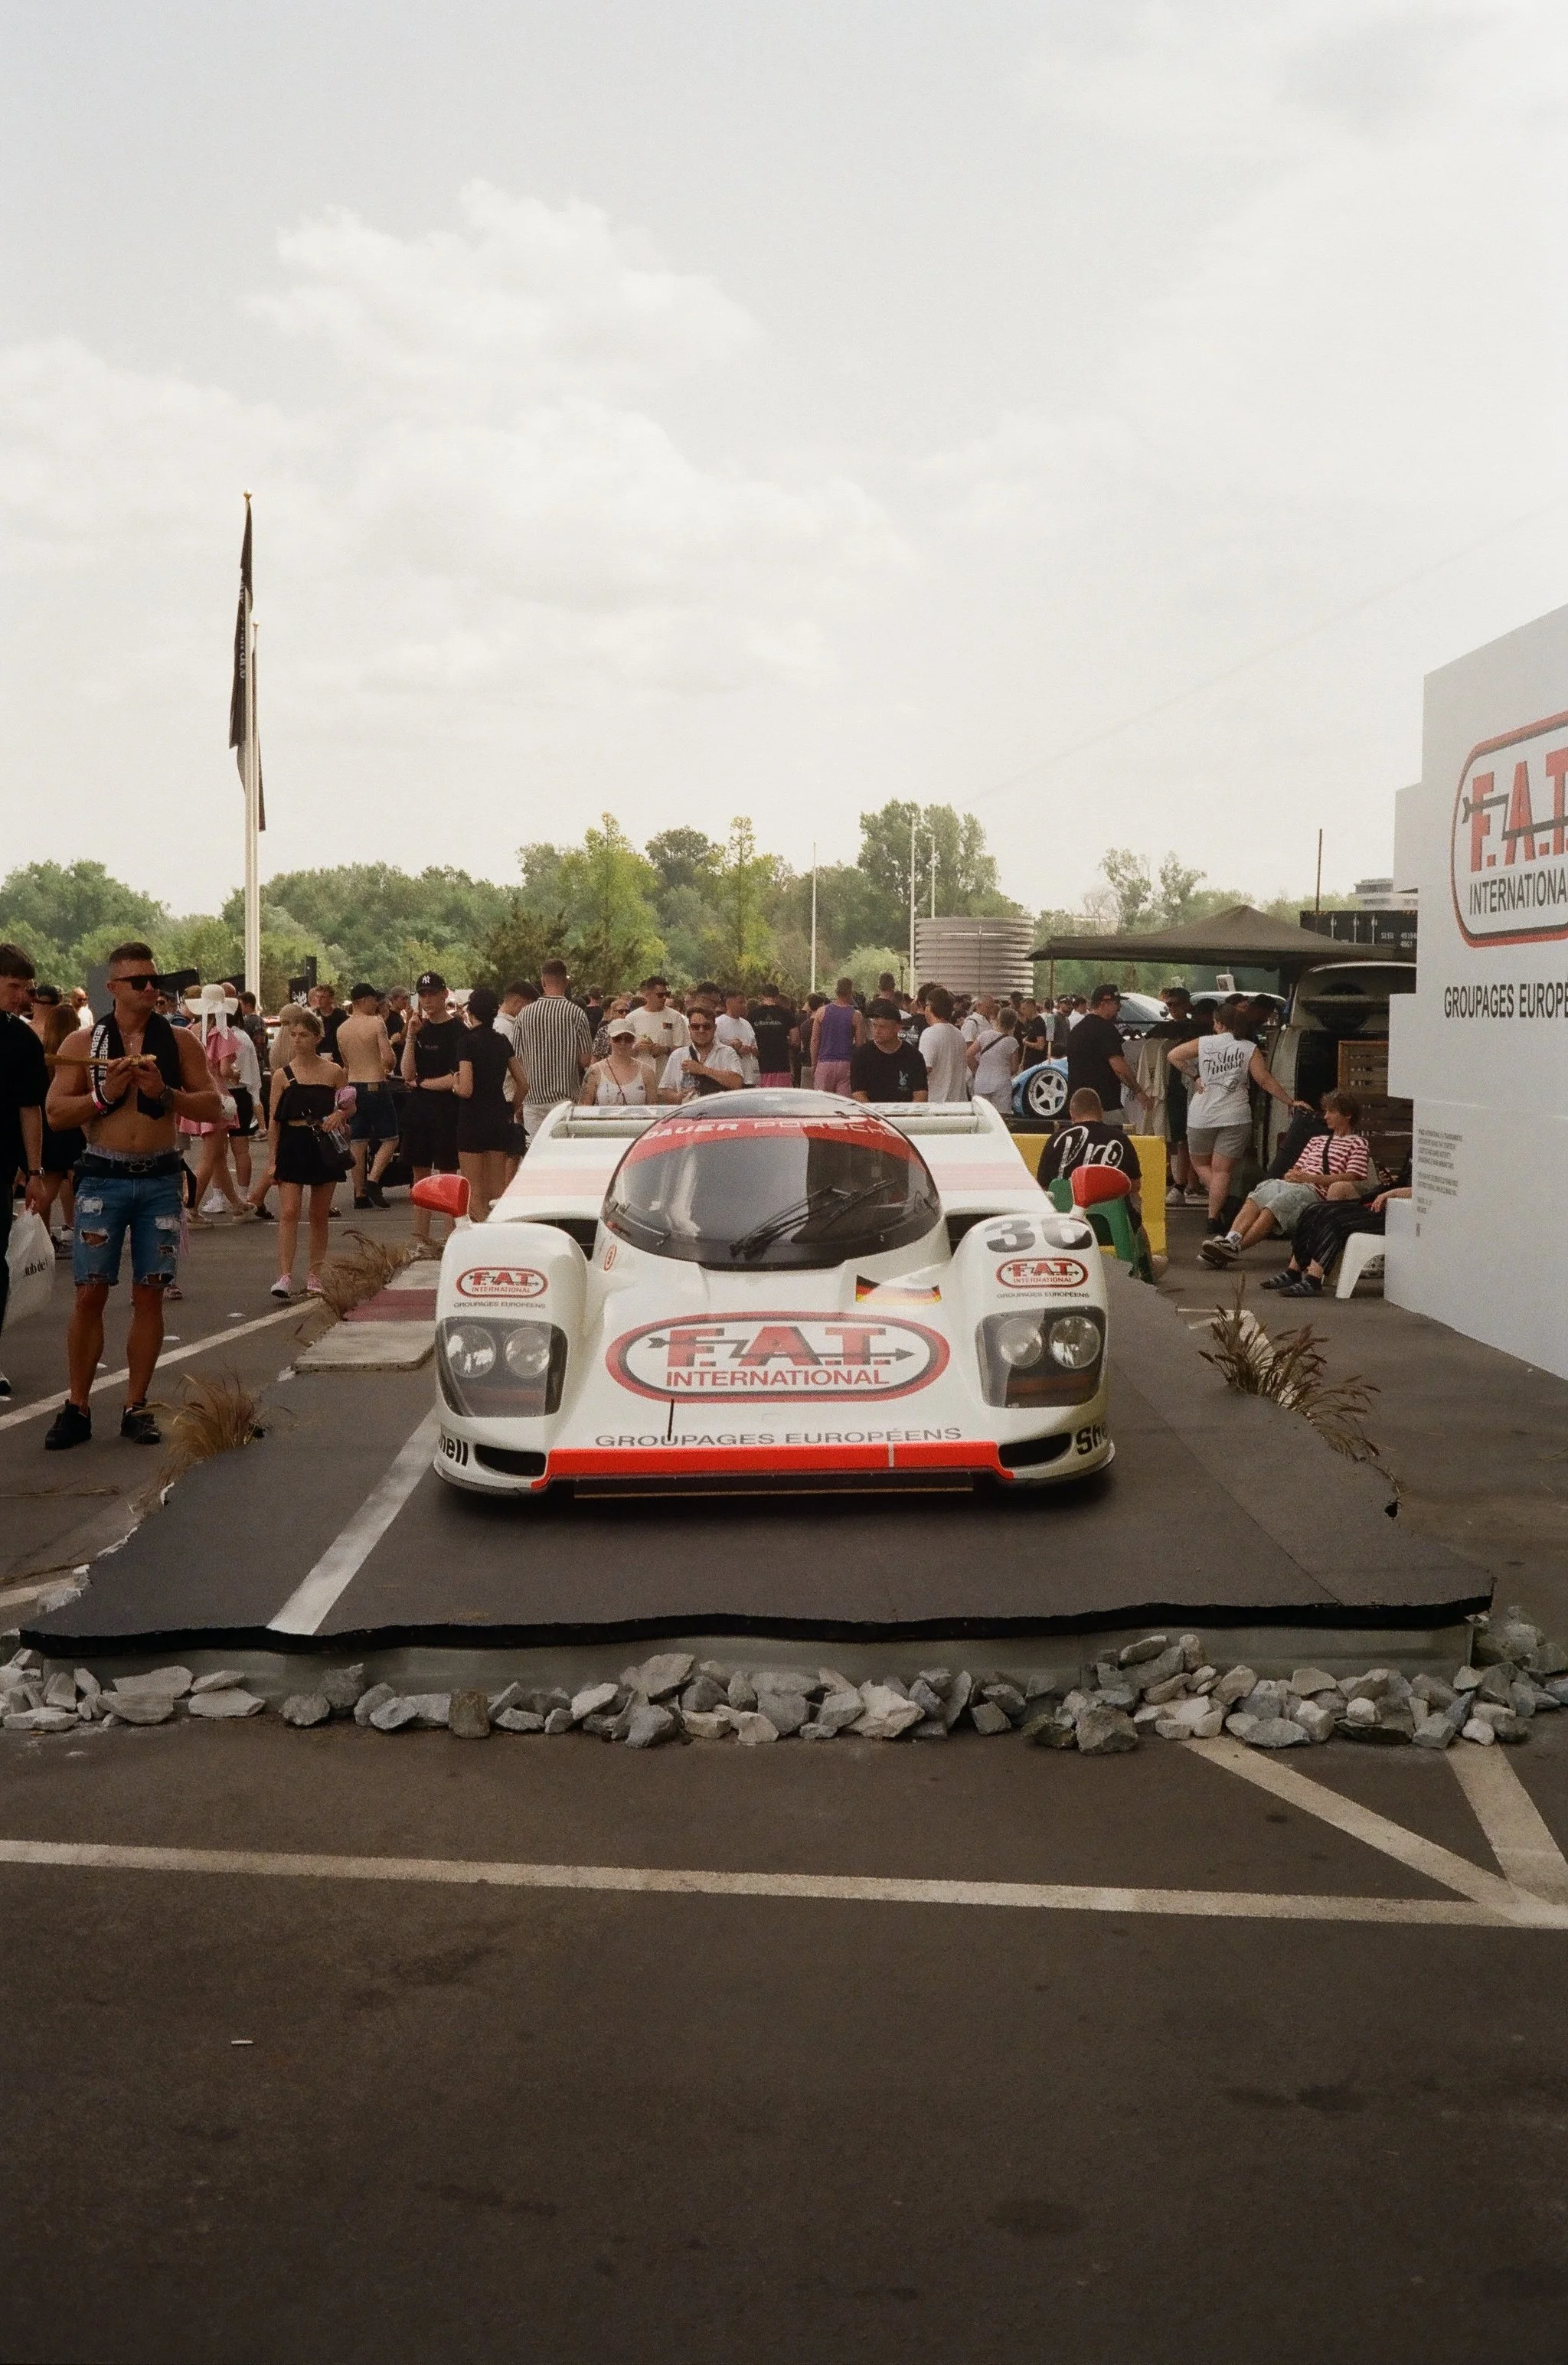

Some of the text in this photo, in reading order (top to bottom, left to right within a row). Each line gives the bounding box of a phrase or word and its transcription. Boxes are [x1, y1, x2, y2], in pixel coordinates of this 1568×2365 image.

[1444, 983, 1514, 1018] GROUPAGES
[1217, 1045, 1244, 1063] Auto
[985, 1217, 1093, 1253] 36
[665, 1368, 890, 1387] INTERNATIONAL
[596, 1427, 962, 1448] GROUPAGES EUROPÉENS
